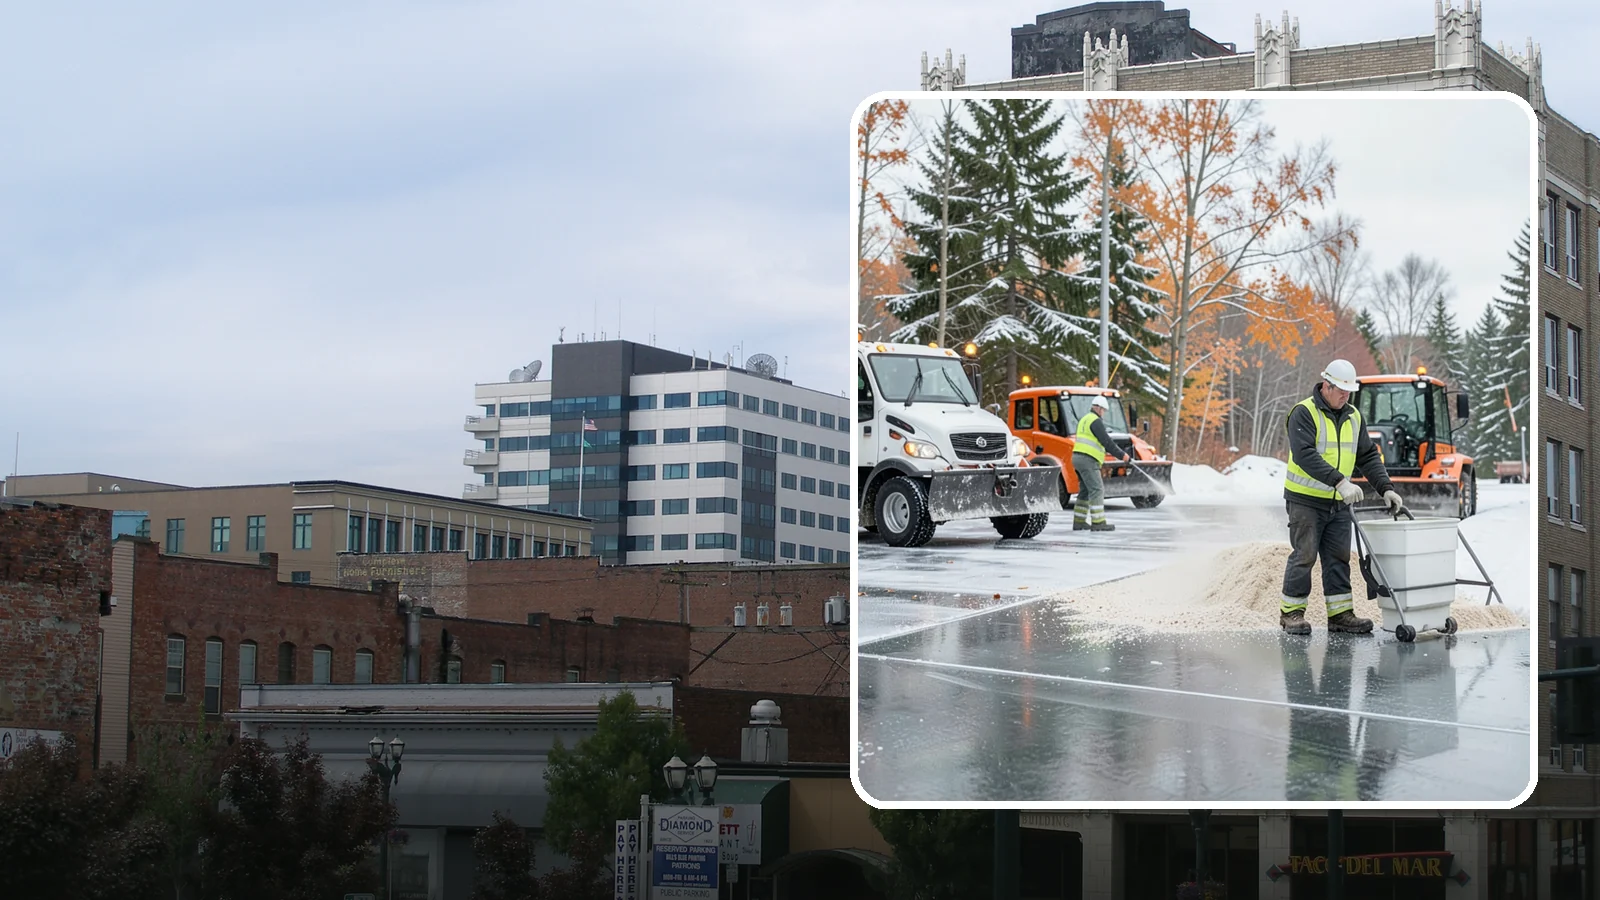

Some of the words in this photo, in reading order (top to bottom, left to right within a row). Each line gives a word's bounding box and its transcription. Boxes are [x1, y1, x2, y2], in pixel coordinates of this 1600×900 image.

[370, 566, 426, 576] Furnishers
[660, 818, 713, 832] DIAMOND
[1022, 815, 1069, 827] BUILDING
[617, 825, 625, 852] PAY
[629, 825, 637, 852] PAY
[722, 852, 739, 862] Soup
[617, 856, 625, 893] HERE
[628, 856, 636, 893] HERE
[1289, 856, 1329, 874] TAC
[1346, 856, 1384, 875] DEL
[1392, 857, 1443, 877] MAR
[661, 889, 682, 897] PUBLIC
[684, 889, 710, 898] PARKING
